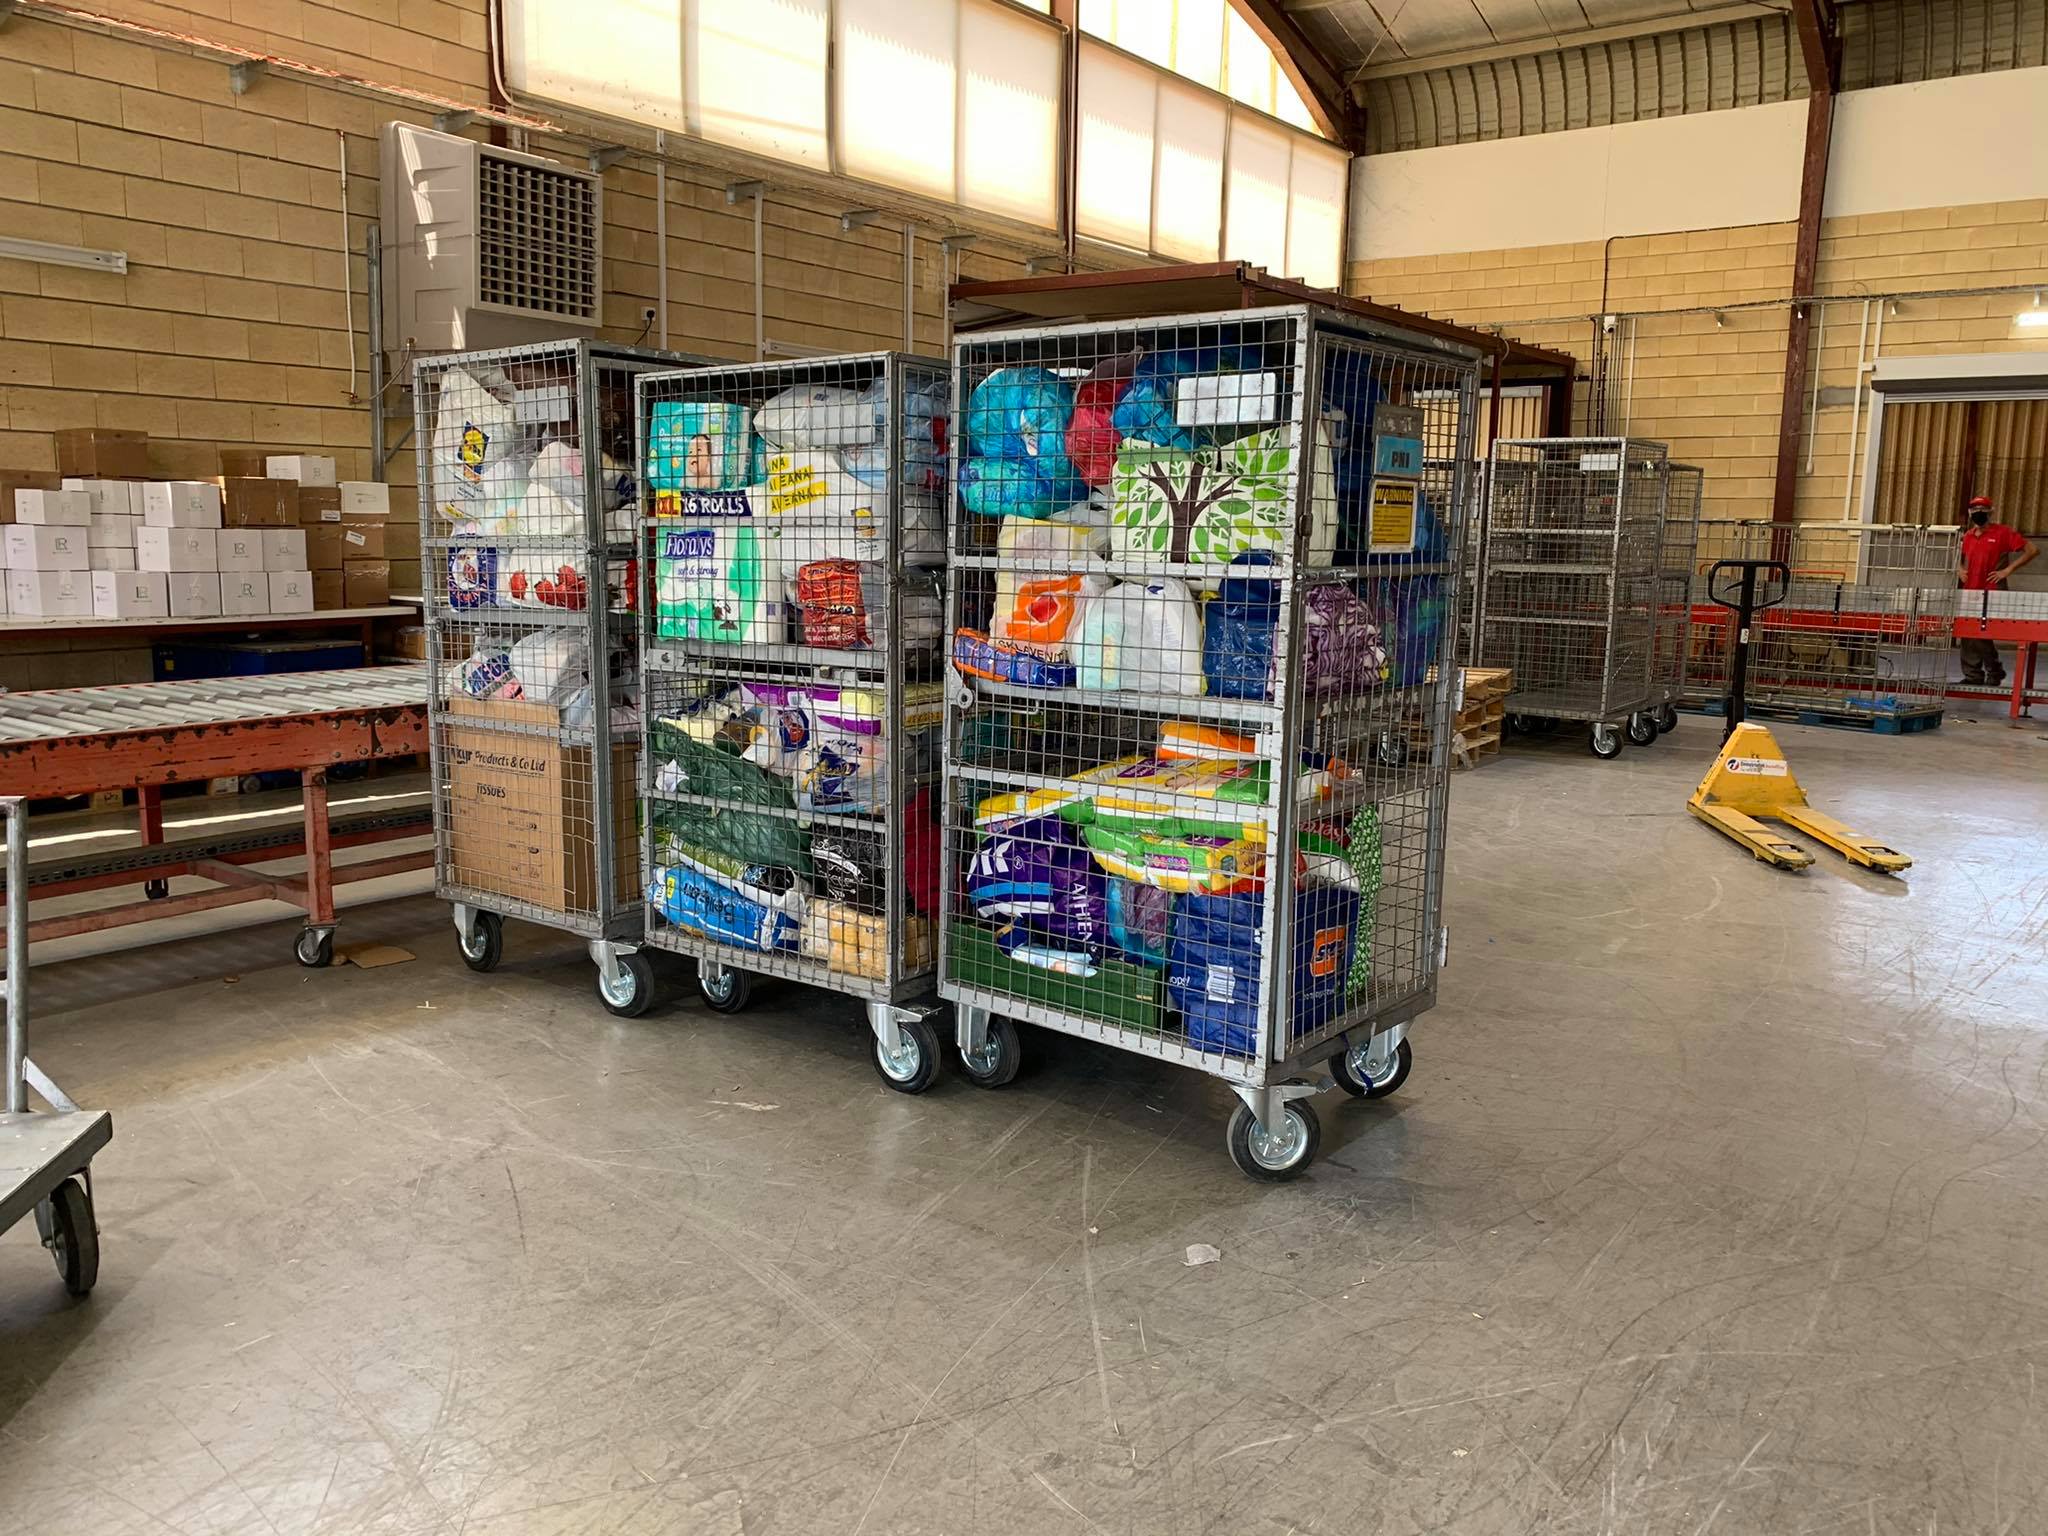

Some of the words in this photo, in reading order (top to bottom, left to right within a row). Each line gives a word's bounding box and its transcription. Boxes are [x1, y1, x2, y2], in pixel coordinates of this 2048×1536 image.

[1376, 488, 1413, 502] WARNING
[682, 496, 697, 514] 16
[700, 496, 744, 515] ROLLS
[476, 783, 506, 799] TISSUES
